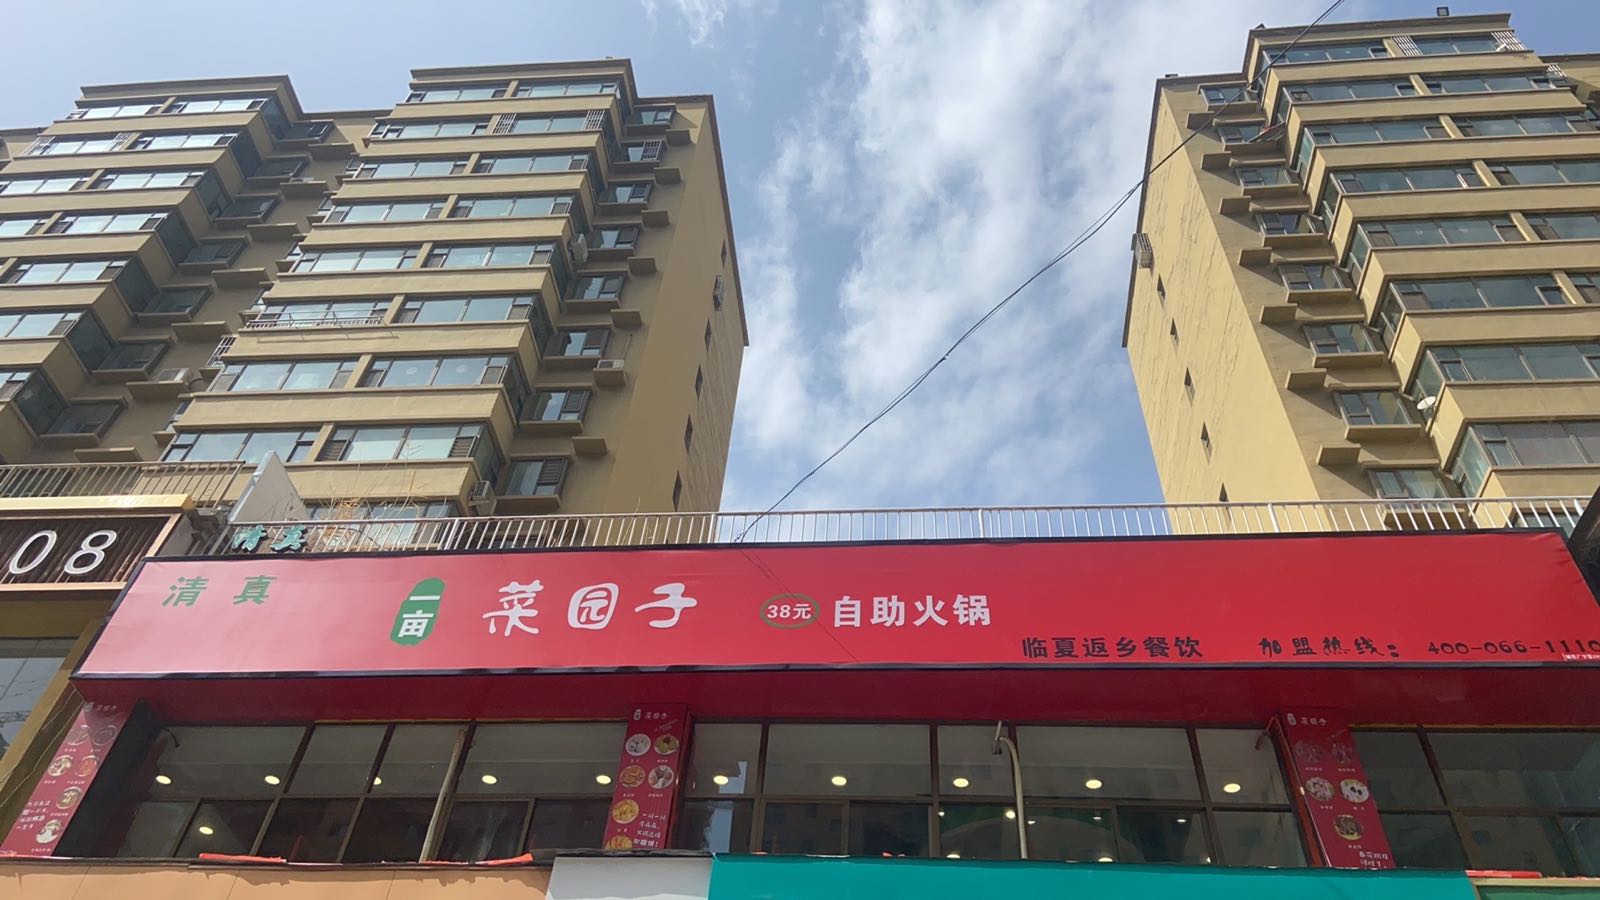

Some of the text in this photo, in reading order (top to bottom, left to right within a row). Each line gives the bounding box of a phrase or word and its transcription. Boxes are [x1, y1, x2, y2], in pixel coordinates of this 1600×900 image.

[162, 574, 277, 608] 清真
[482, 579, 698, 637] 菜园子
[398, 595, 441, 638] 一亩
[767, 603, 812, 620] 38元
[833, 594, 991, 628] 自助火锅
[1022, 636, 1204, 659] 临夏返乡餐饮
